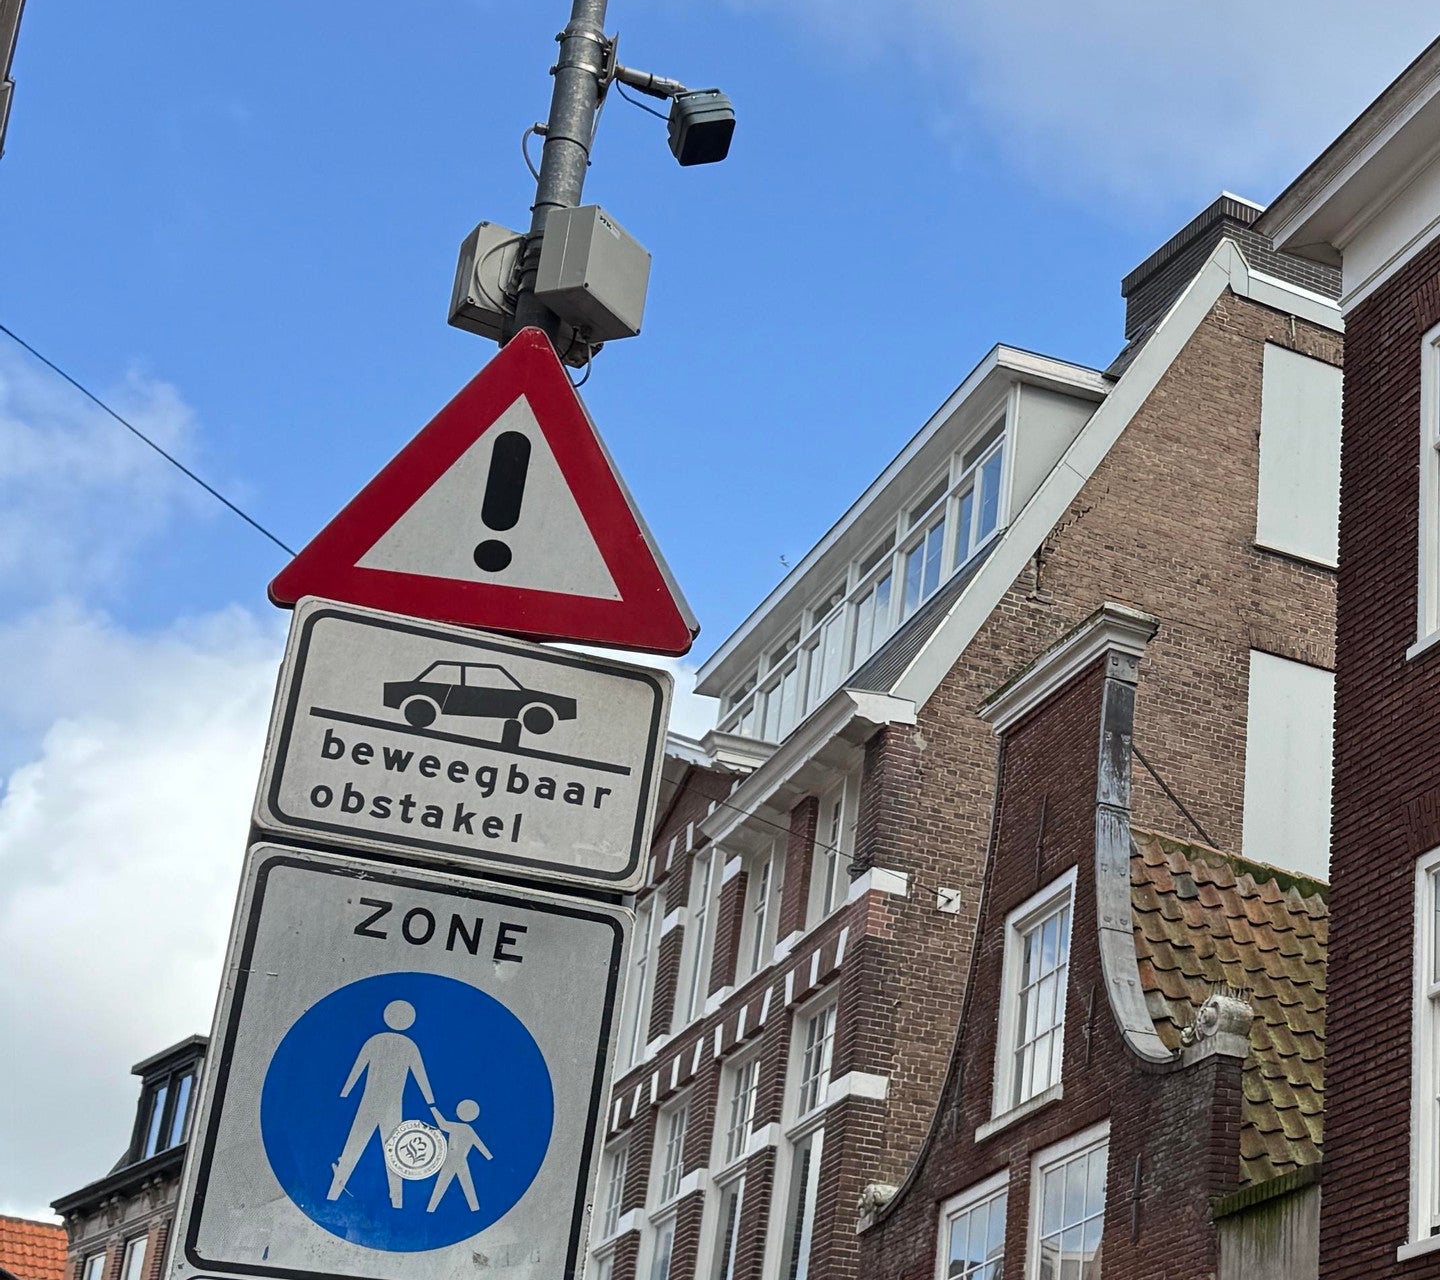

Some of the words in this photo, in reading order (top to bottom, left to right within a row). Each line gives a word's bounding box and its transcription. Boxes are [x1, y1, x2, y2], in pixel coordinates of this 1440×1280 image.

[321, 728, 612, 809] beweegbaar
[310, 782, 523, 843] obstakel
[353, 897, 528, 963] ZONE
